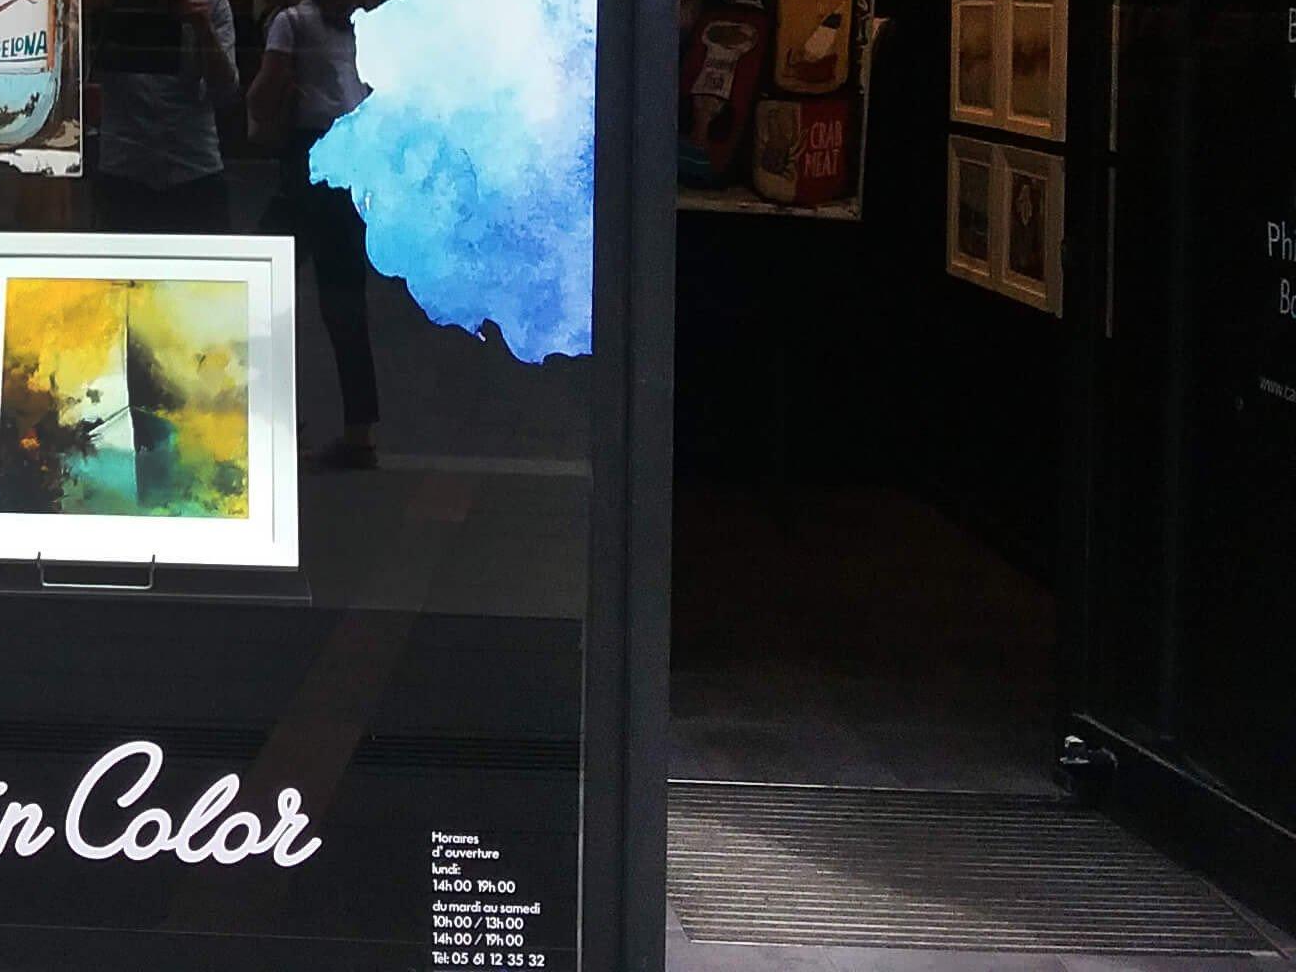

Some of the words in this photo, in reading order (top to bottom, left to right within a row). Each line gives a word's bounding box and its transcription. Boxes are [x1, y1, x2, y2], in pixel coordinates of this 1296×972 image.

[66, 740, 322, 867] Color
[431, 831, 480, 845] Horaires
[432, 900, 447, 913] du
[449, 900, 481, 914] mardi
[483, 904, 498, 914] au
[500, 902, 541, 915] samedi
[451, 952, 469, 965] 05
[472, 953, 485, 966] 61
[489, 953, 503, 966] 12
[507, 954, 524, 967] 35
[528, 954, 545, 968] 32
